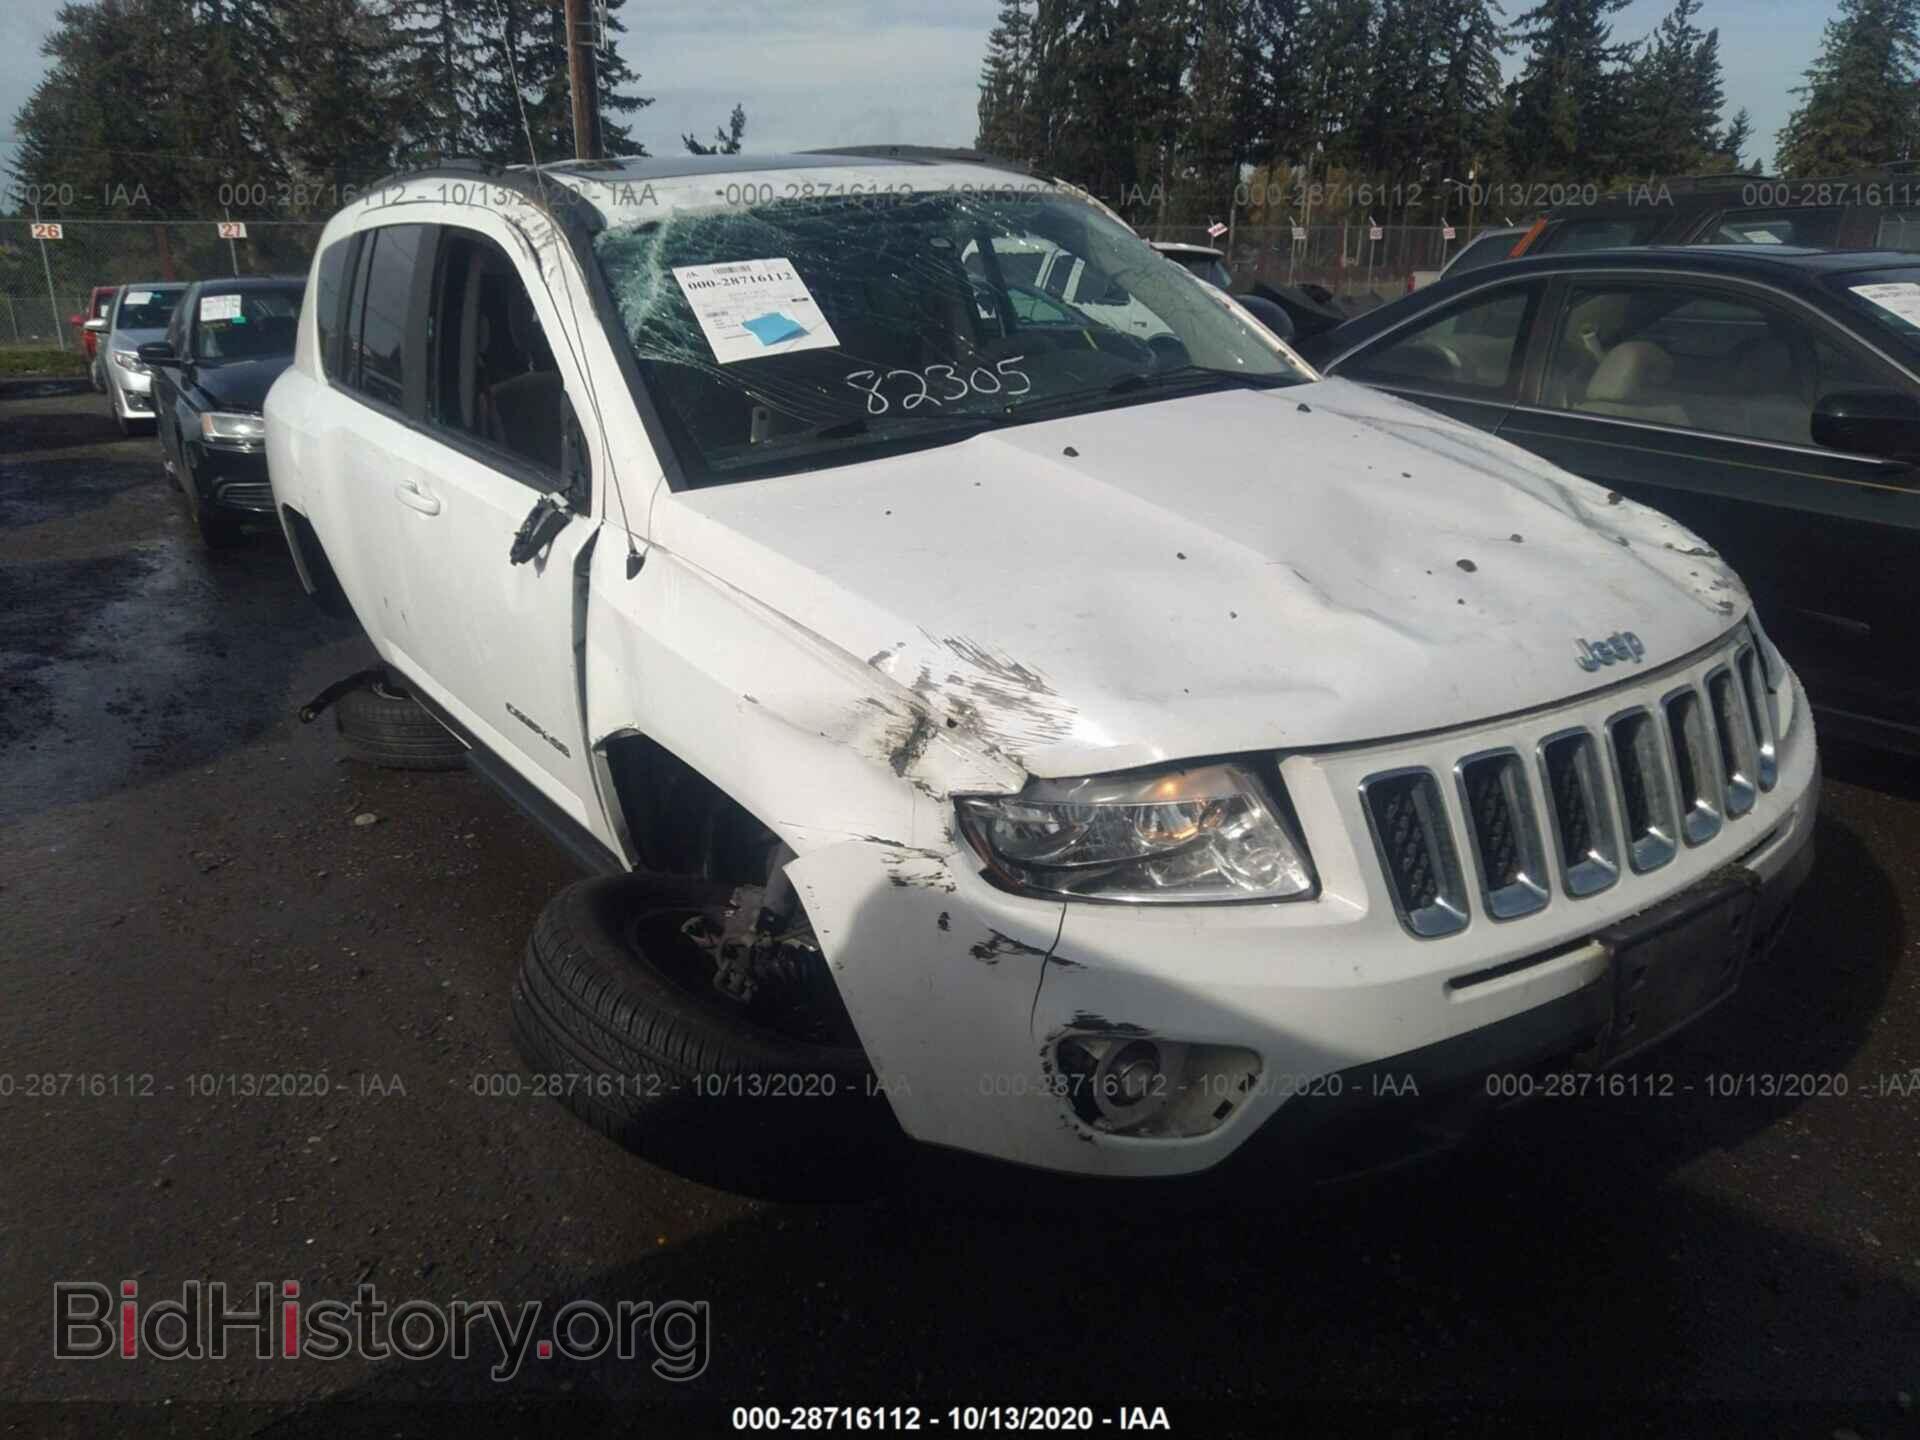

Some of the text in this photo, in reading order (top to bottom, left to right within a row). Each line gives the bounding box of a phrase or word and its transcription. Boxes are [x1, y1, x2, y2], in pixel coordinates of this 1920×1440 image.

[34, 225, 60, 238] 26
[221, 223, 243, 238] 27
[687, 272, 794, 290] 000-28716112
[846, 355, 1031, 415] 82305
[1575, 631, 1645, 672] Jeep
